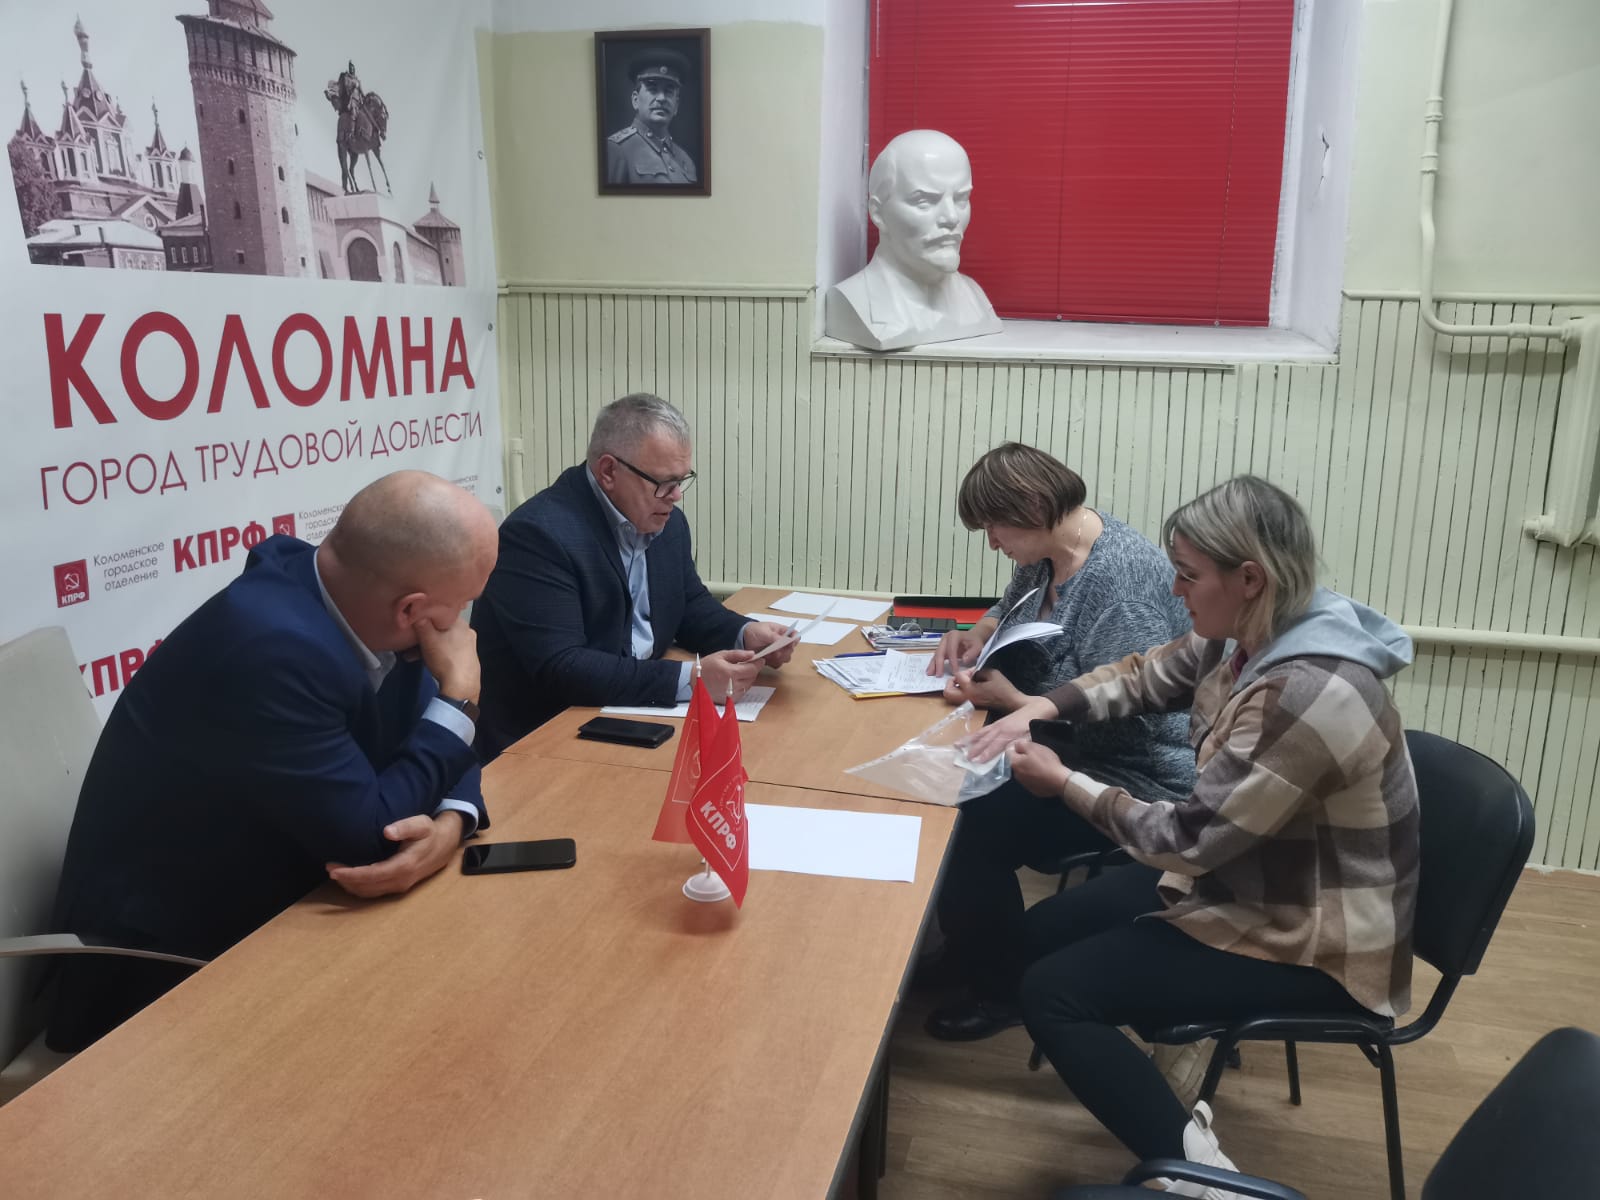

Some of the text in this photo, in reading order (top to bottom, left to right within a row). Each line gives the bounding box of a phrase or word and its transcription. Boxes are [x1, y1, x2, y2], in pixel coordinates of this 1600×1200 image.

[43, 311, 475, 429] КОЛОМНА
[40, 410, 483, 510] ГОРОД ТРУДОВОЙ ДОБЛЕСТИ
[93, 541, 165, 567] Коломенское
[103, 556, 158, 579] городское
[173, 520, 267, 573] КПРФ
[61, 590, 86, 605] КПРФ
[104, 568, 159, 592] отделение
[79, 638, 163, 699] ПР
[700, 800, 737, 850] КПРФ
